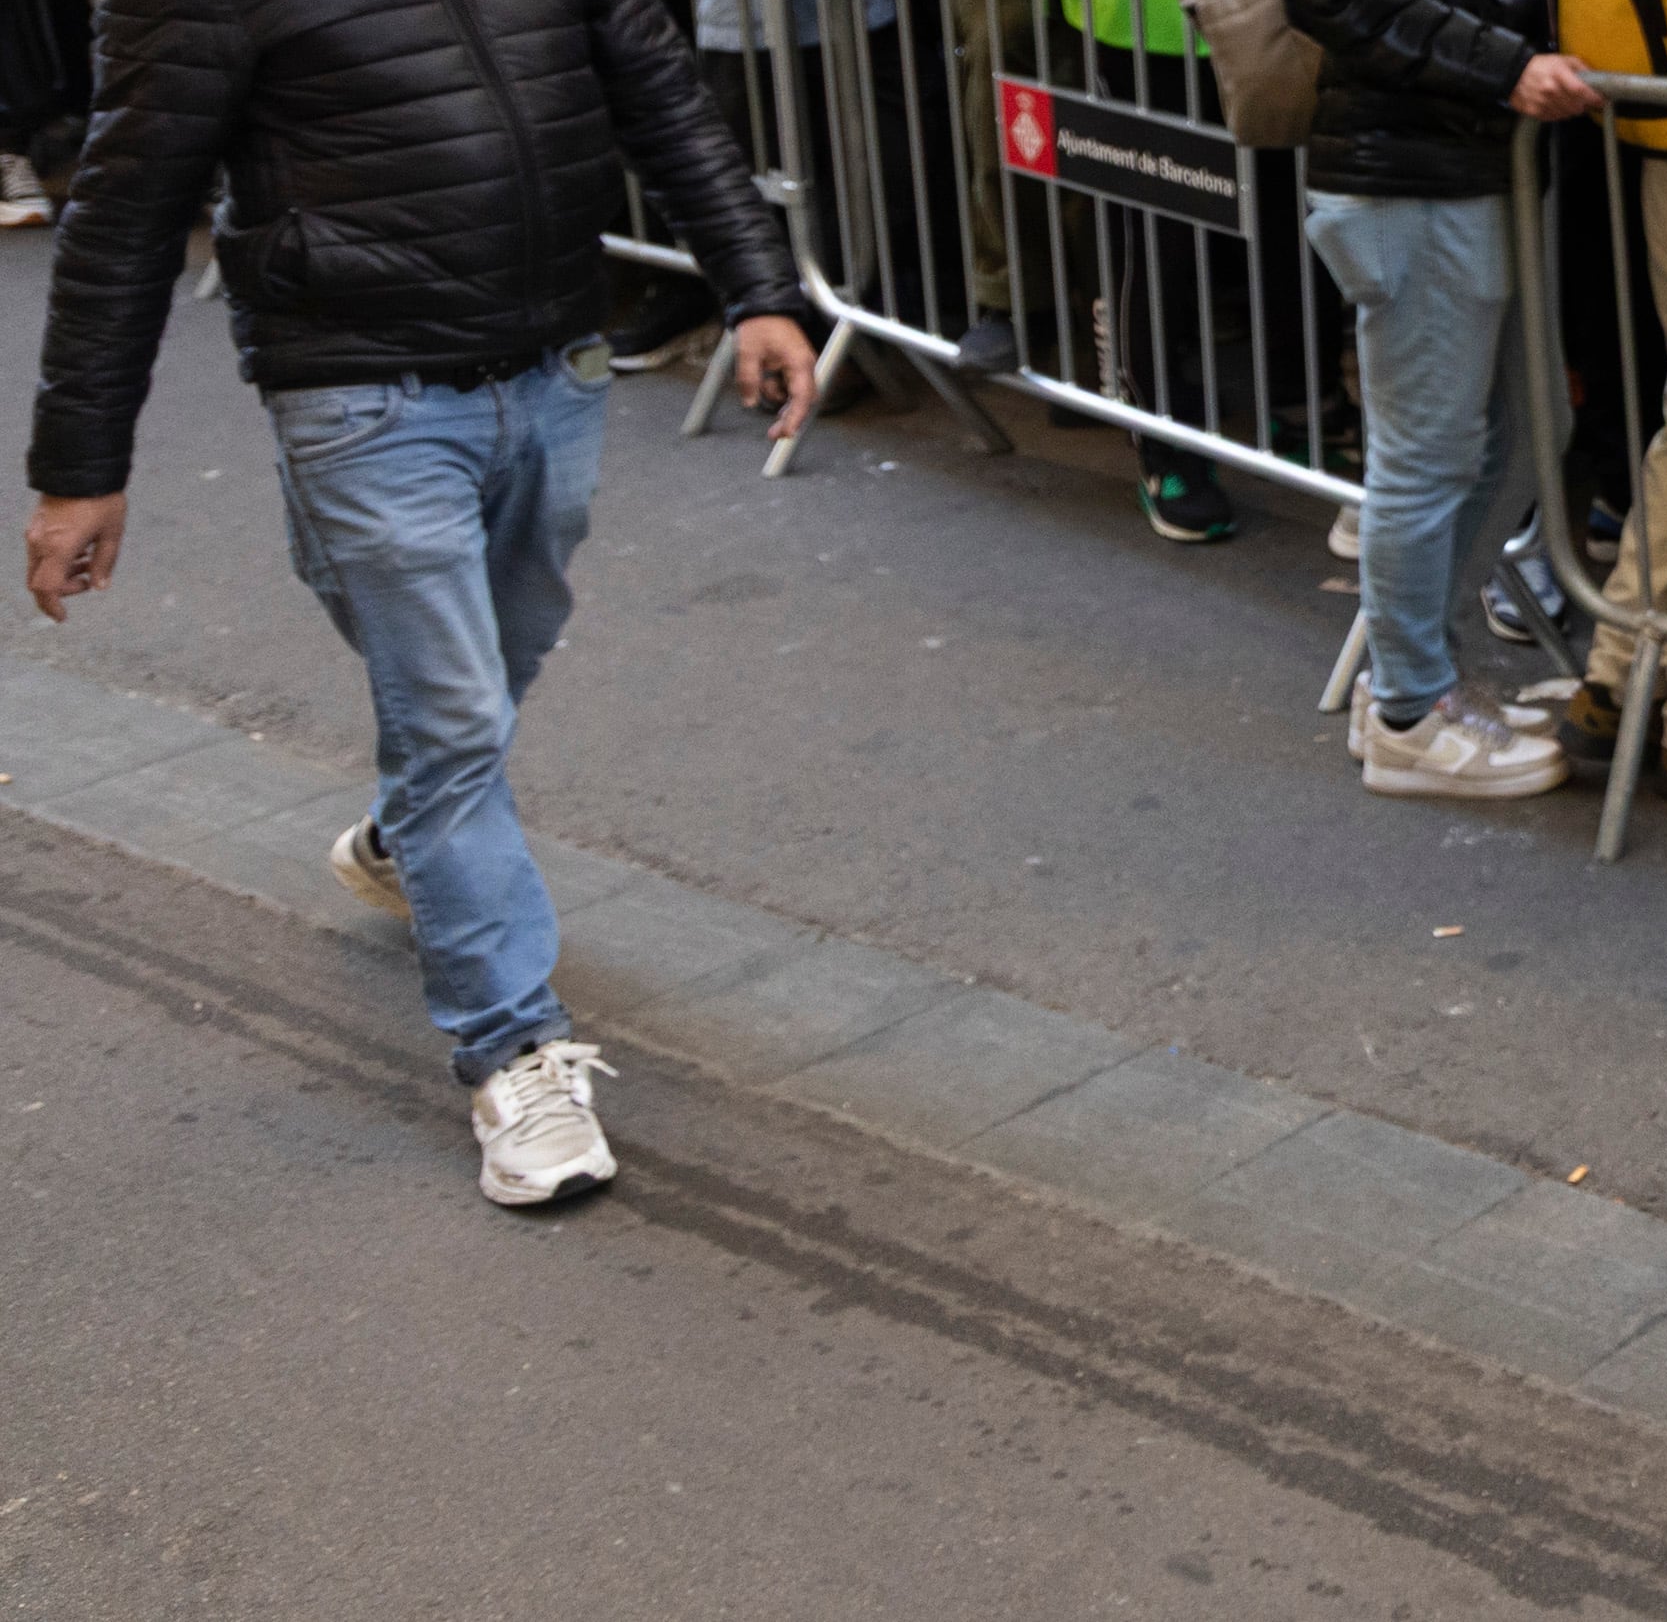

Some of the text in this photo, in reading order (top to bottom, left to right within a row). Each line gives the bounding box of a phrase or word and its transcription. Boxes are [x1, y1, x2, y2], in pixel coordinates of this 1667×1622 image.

[1056, 127, 1236, 198] Ajuntament de Barcelona
